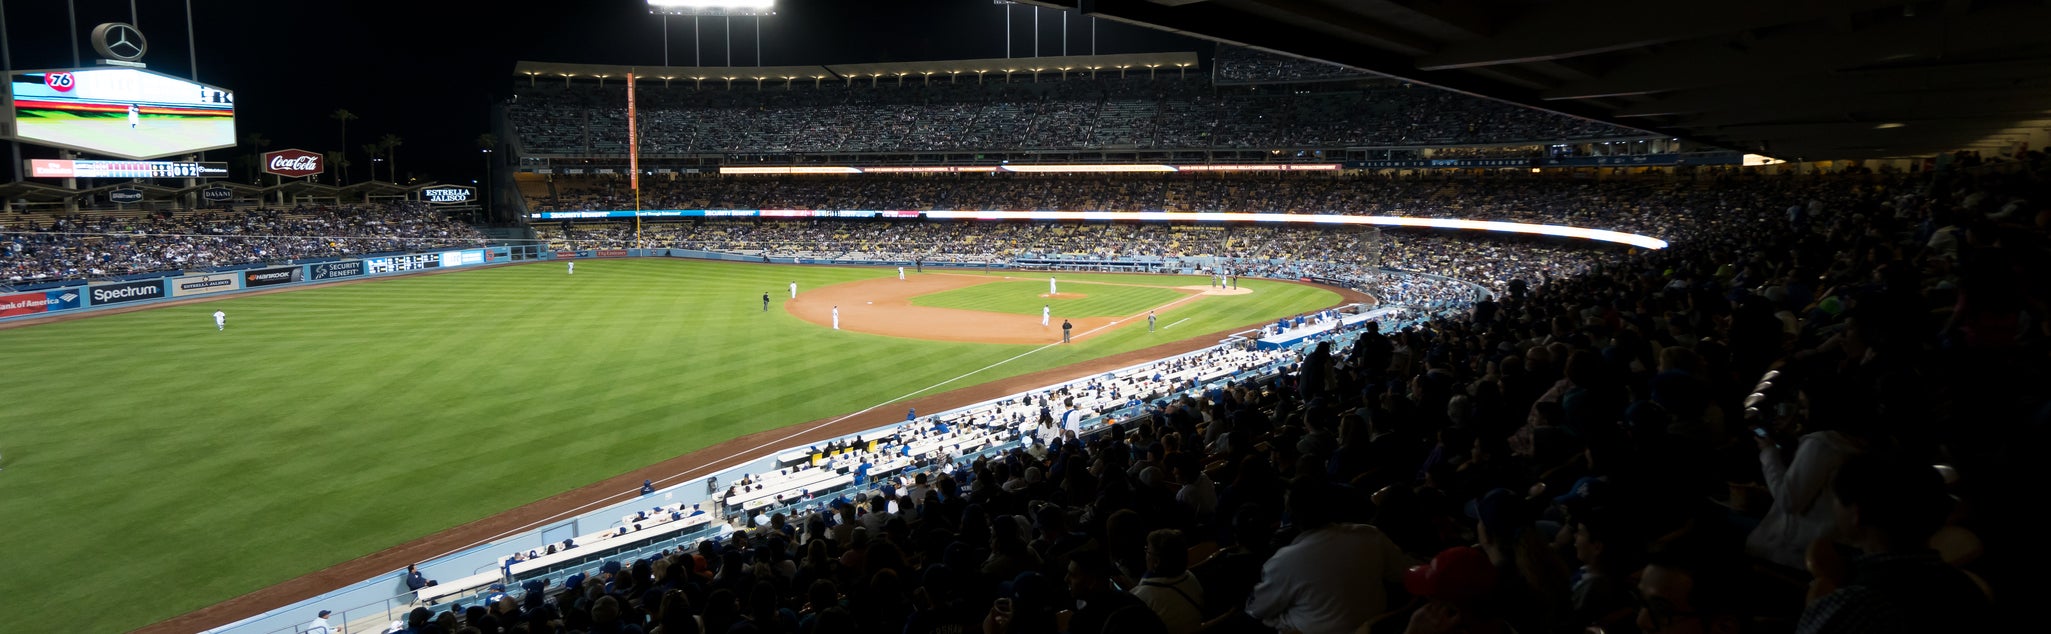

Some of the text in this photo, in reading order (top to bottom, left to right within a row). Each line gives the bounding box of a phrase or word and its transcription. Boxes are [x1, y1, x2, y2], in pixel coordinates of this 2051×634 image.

[51, 74, 71, 86] 76
[270, 155, 318, 170] Coca-Cola
[330, 262, 360, 270] SECURITY
[330, 269, 357, 277] BENEFIT
[94, 285, 157, 301] Spectrum
[0, 298, 60, 310] ank of America
